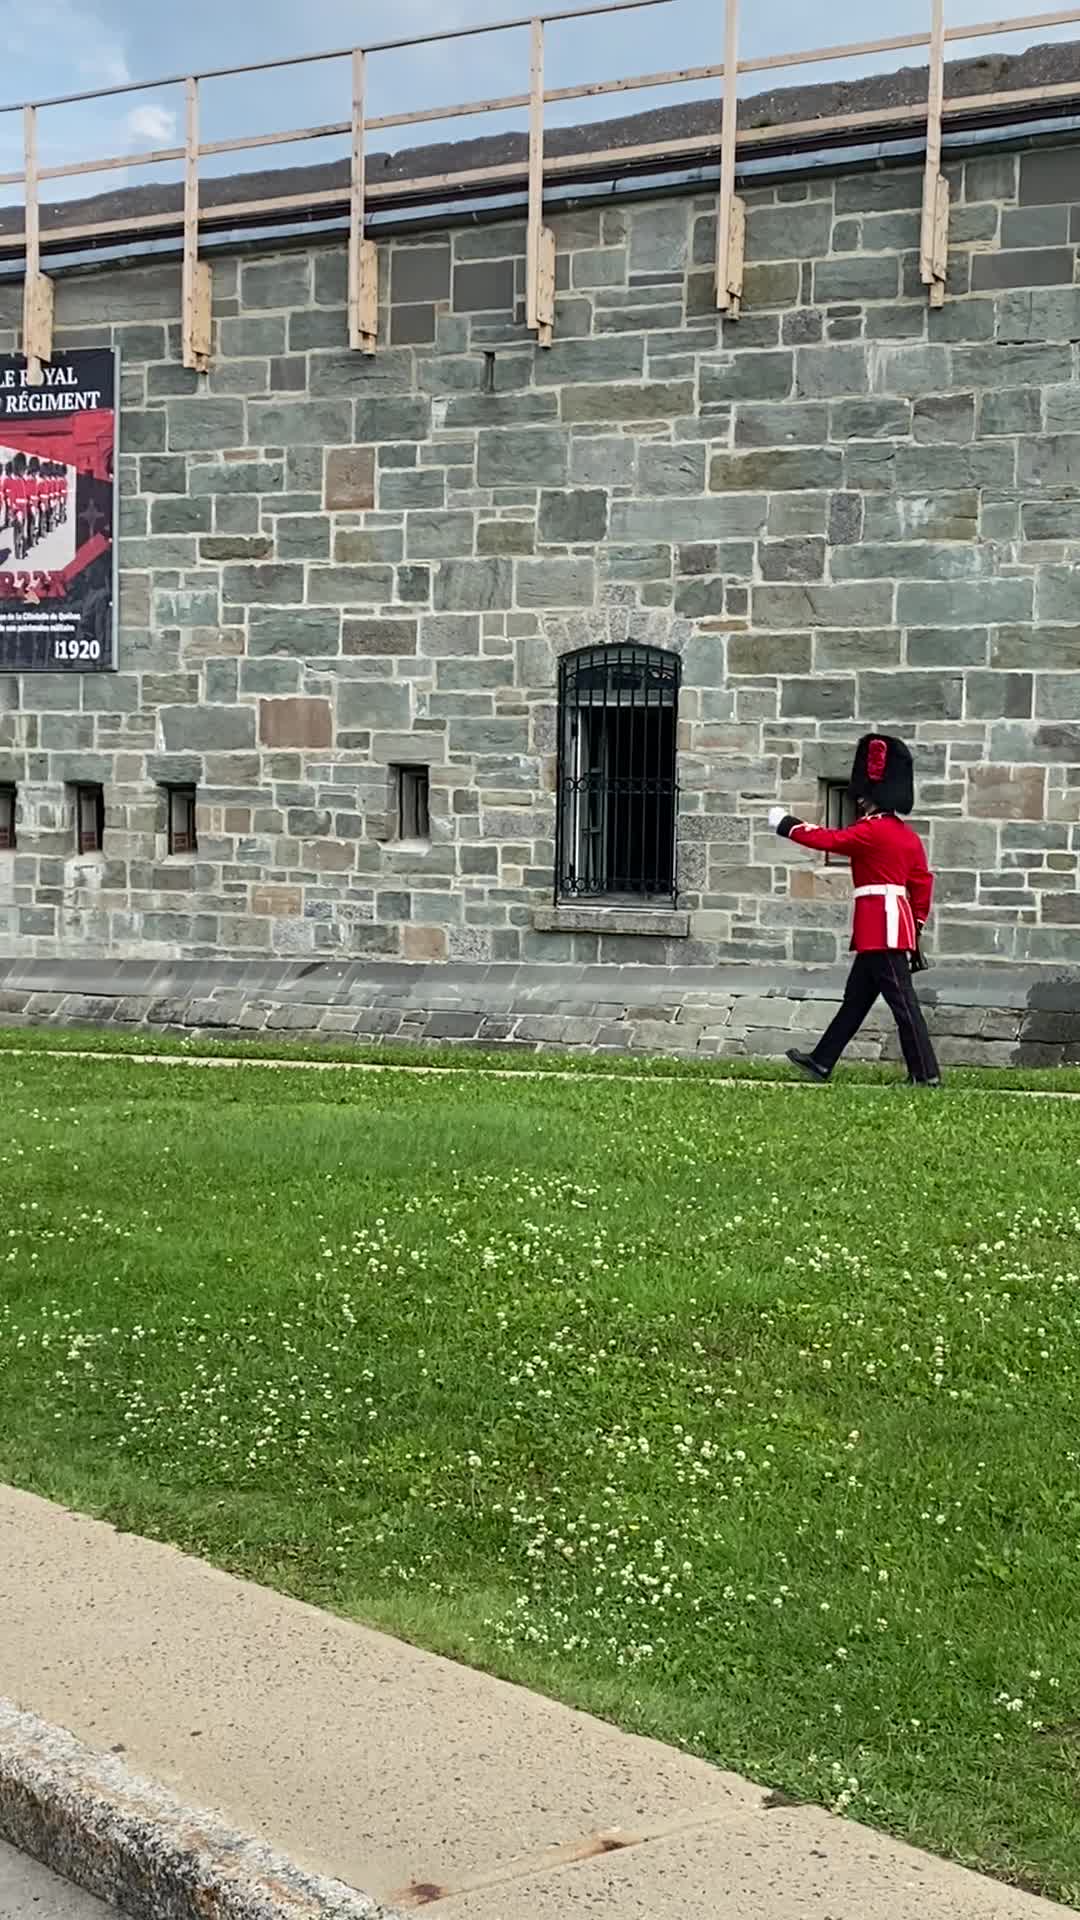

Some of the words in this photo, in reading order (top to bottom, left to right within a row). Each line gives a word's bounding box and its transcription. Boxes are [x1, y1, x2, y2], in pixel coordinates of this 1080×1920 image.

[20, 367, 78, 387] RYAL
[6, 391, 100, 413] RÉGIMENT
[60, 640, 100, 659] 1920
